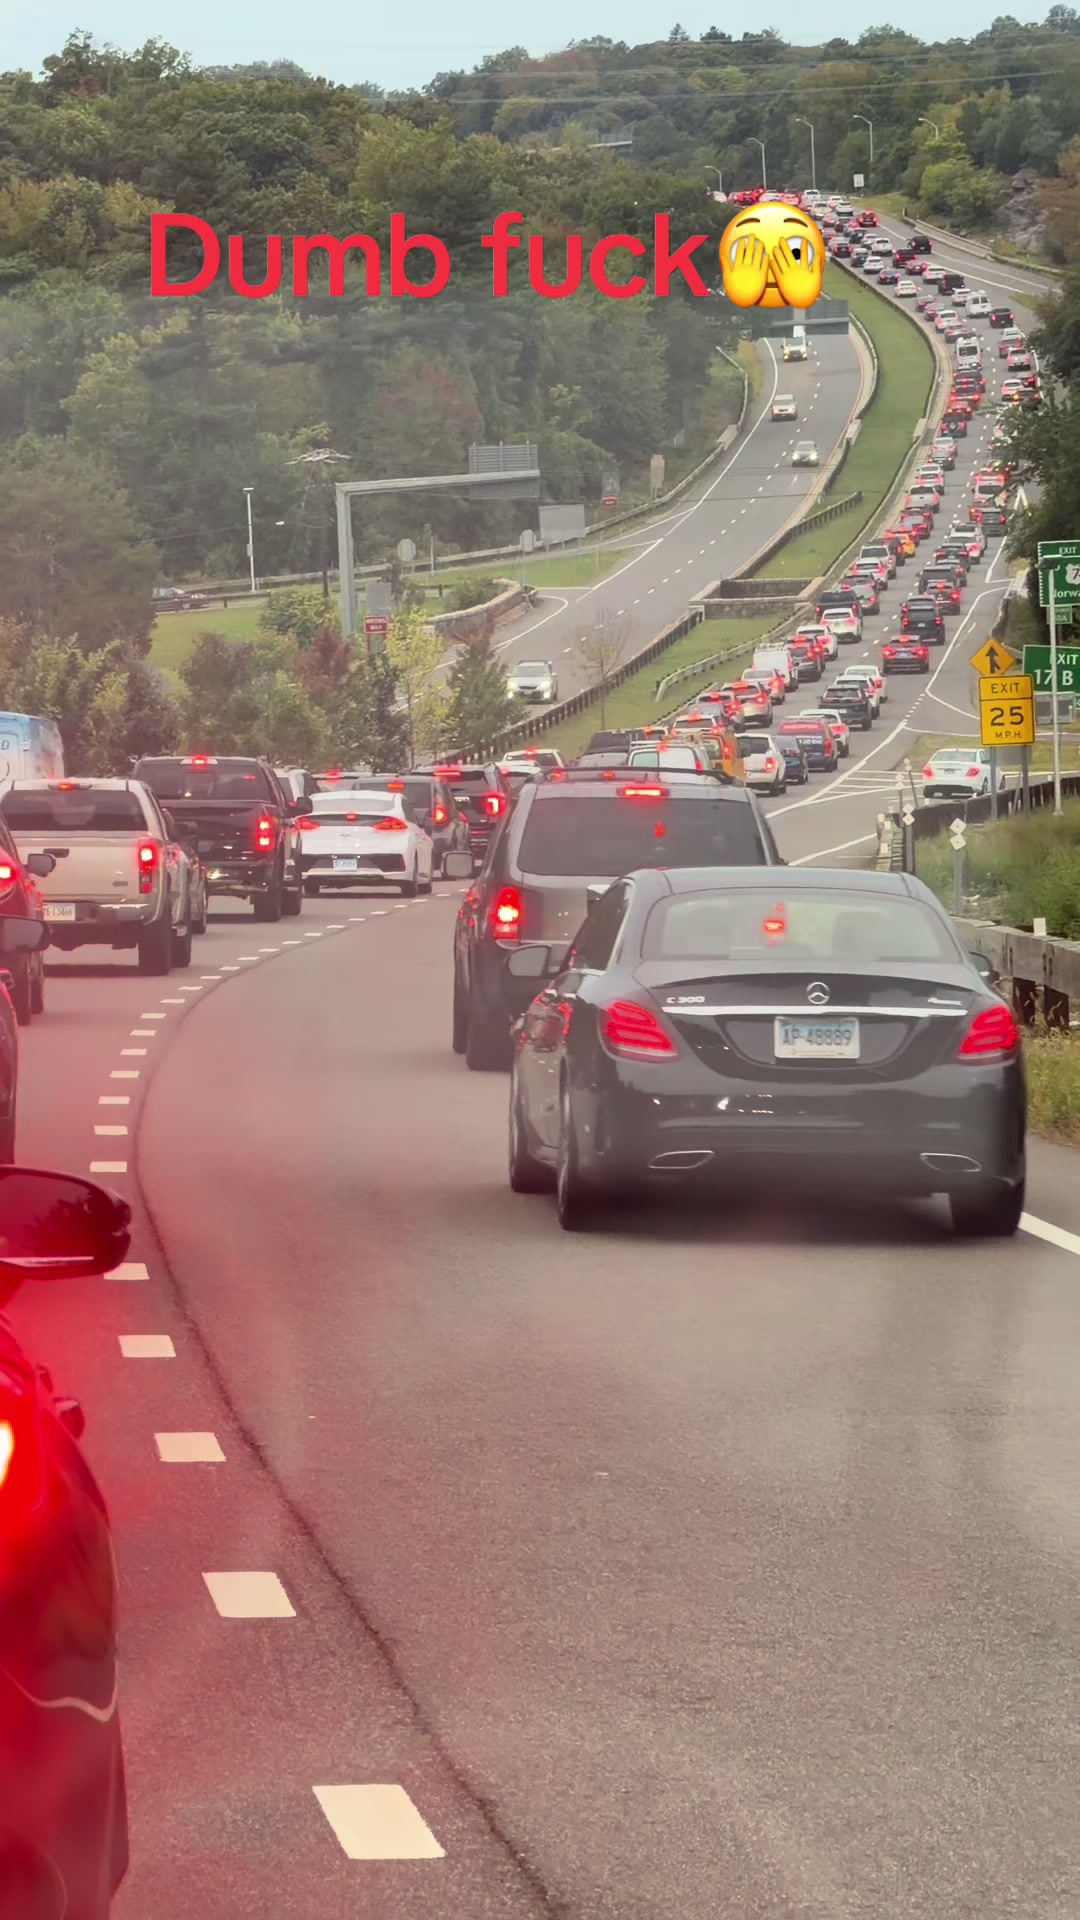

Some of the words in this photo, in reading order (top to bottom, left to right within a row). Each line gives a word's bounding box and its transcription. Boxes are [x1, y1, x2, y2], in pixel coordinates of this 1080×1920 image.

[1059, 546, 1077, 555] EXIT
[1033, 668, 1053, 686] 17
[1061, 669, 1074, 686] B
[991, 682, 1021, 694] EXIT
[990, 706, 1024, 727] 25
